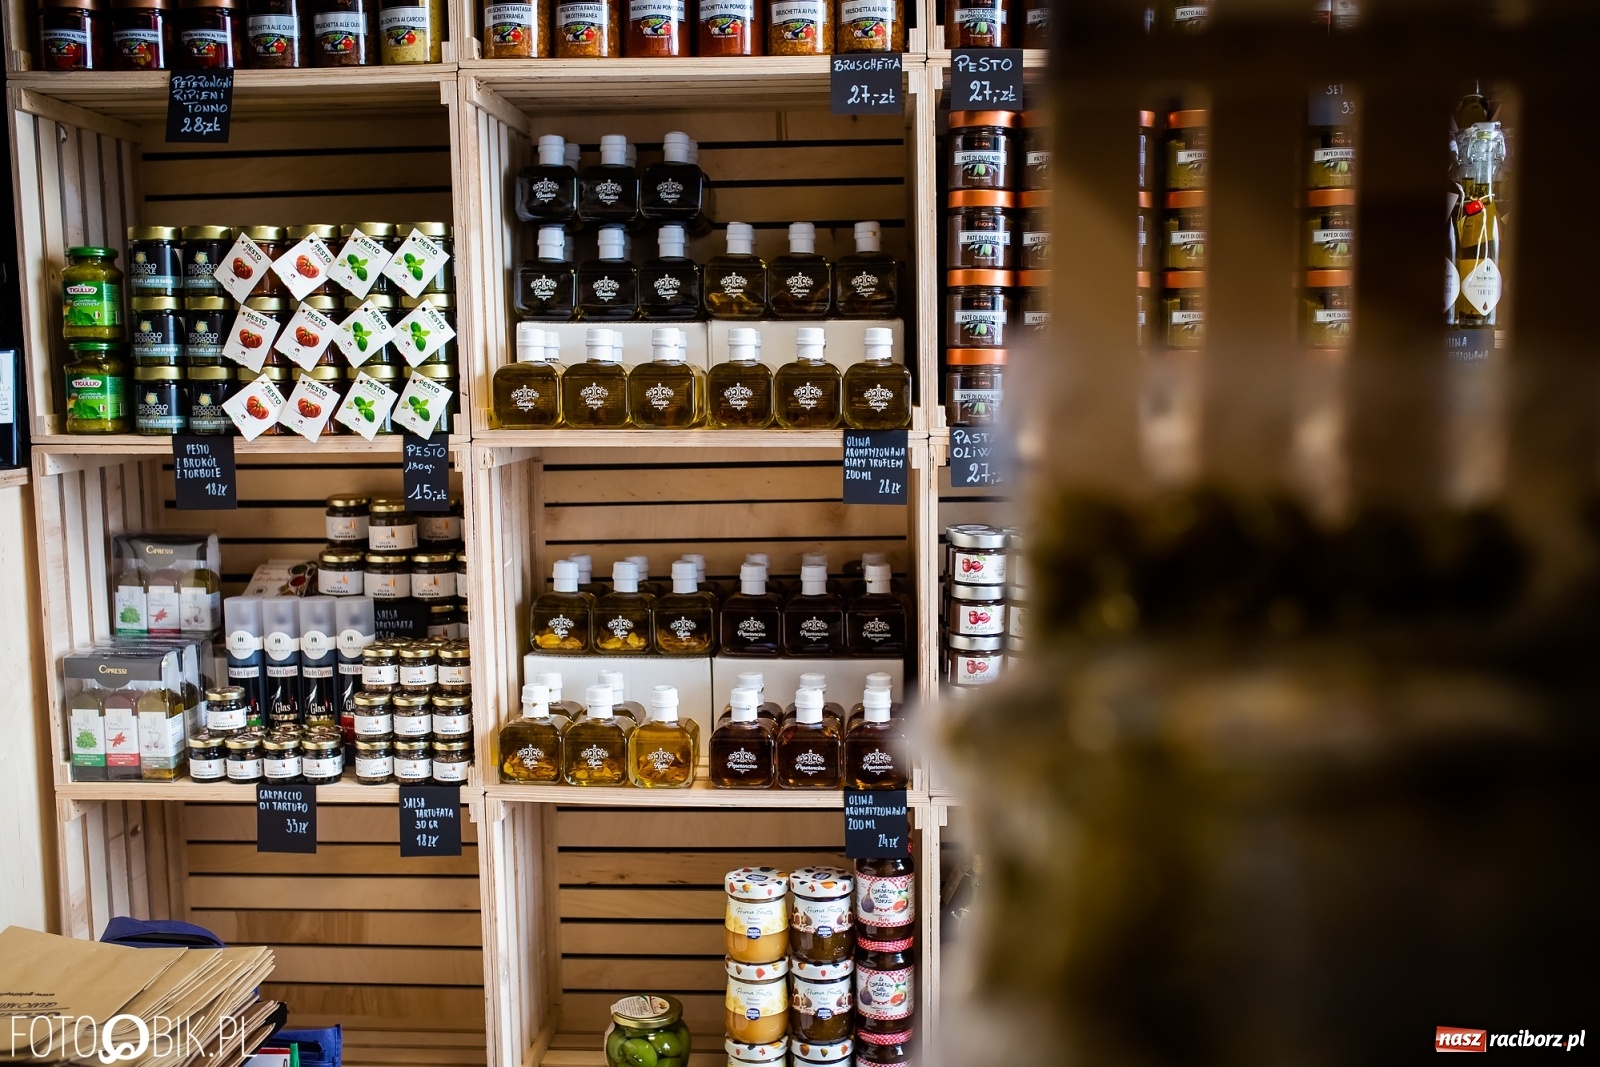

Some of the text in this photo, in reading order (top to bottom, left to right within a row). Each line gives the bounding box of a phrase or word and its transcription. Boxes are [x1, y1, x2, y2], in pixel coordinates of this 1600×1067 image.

[833, 58, 901, 72] BRUSCHETTA
[954, 54, 1013, 73] PESTO
[173, 89, 224, 101] RIPIENI
[183, 101, 228, 113] TONNO
[245, 243, 262, 261] PESTO
[314, 243, 332, 264] PESTO
[361, 238, 380, 255] PESTO
[418, 238, 438, 256] PESTO
[247, 312, 268, 327] PESTO
[306, 311, 327, 328] PESTO
[369, 310, 387, 331] PESTO
[428, 310, 445, 330] PESTO
[307, 382, 328, 397] PESTO
[366, 380, 386, 396] PESTO
[419, 379, 440, 394] PESTO
[264, 384, 282, 406] PESTO
[953, 430, 990, 445] PAST
[186, 443, 210, 455] PESTO
[406, 441, 446, 457] PESTO
[184, 467, 222, 479] TORBOLE
[259, 801, 308, 813] DI TARTUFO
[403, 797, 425, 808] SALSA
[415, 807, 454, 819] TARTUFATA
